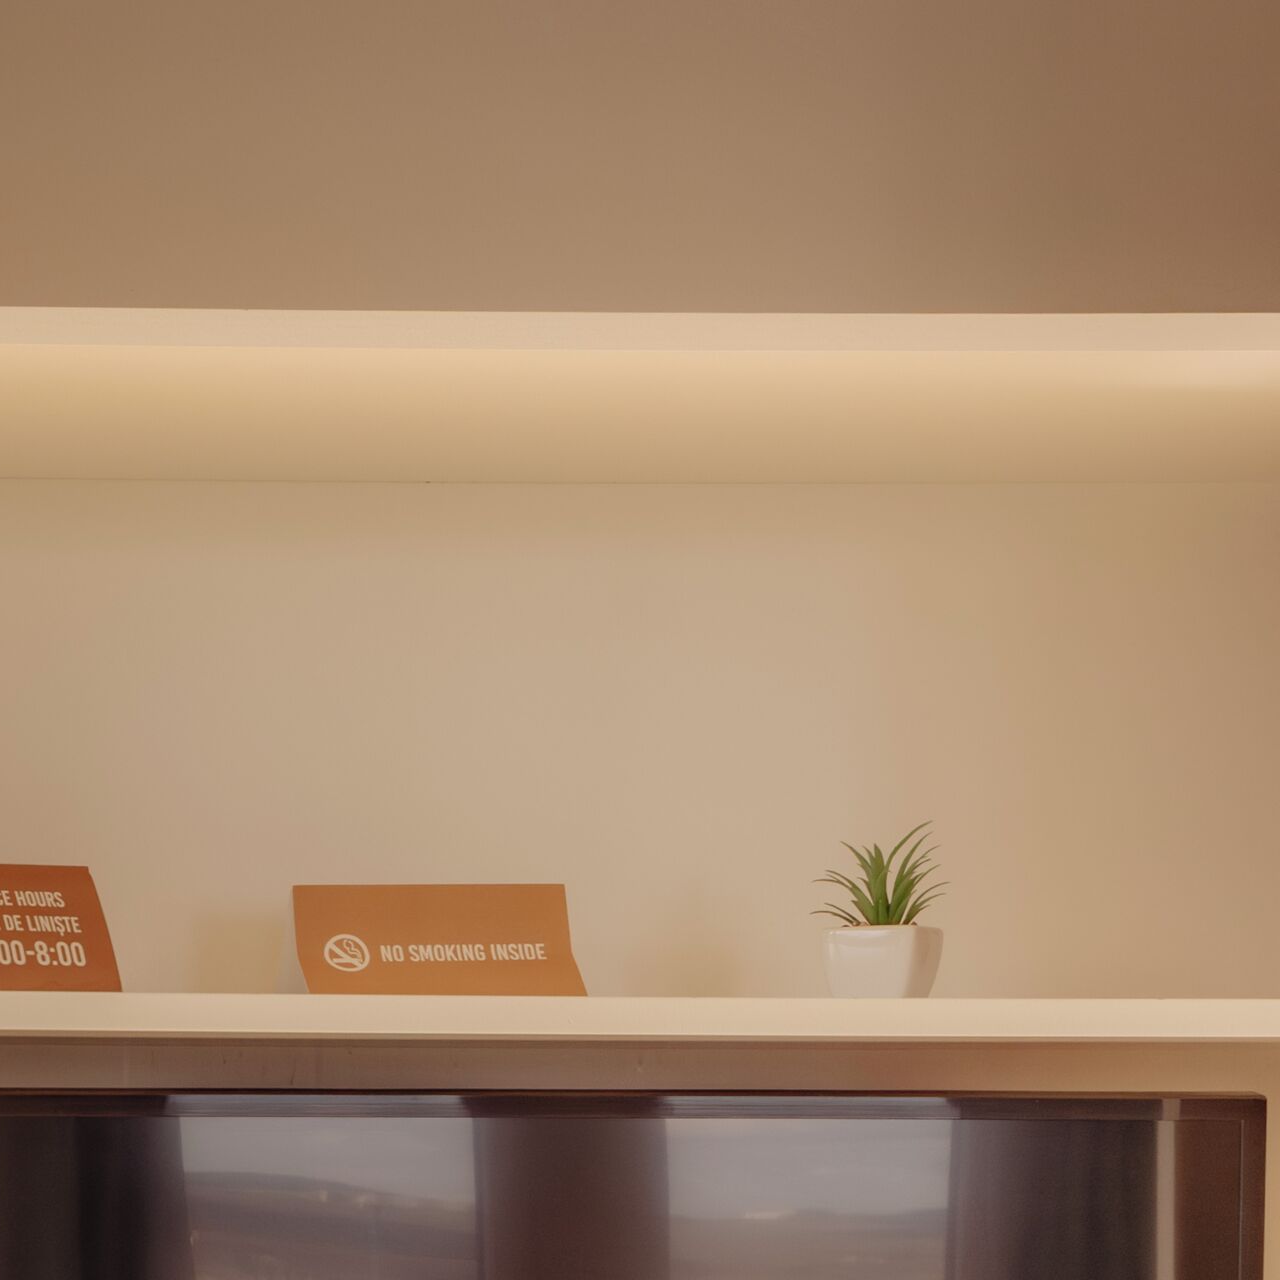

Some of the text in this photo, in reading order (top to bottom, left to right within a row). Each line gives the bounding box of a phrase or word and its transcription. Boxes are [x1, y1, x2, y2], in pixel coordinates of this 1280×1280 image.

[15, 890, 65, 908] HOURS
[3, 914, 25, 931] DE
[28, 915, 82, 936] LINIȘTE
[380, 943, 547, 962] NO SMOKING INSIDE
